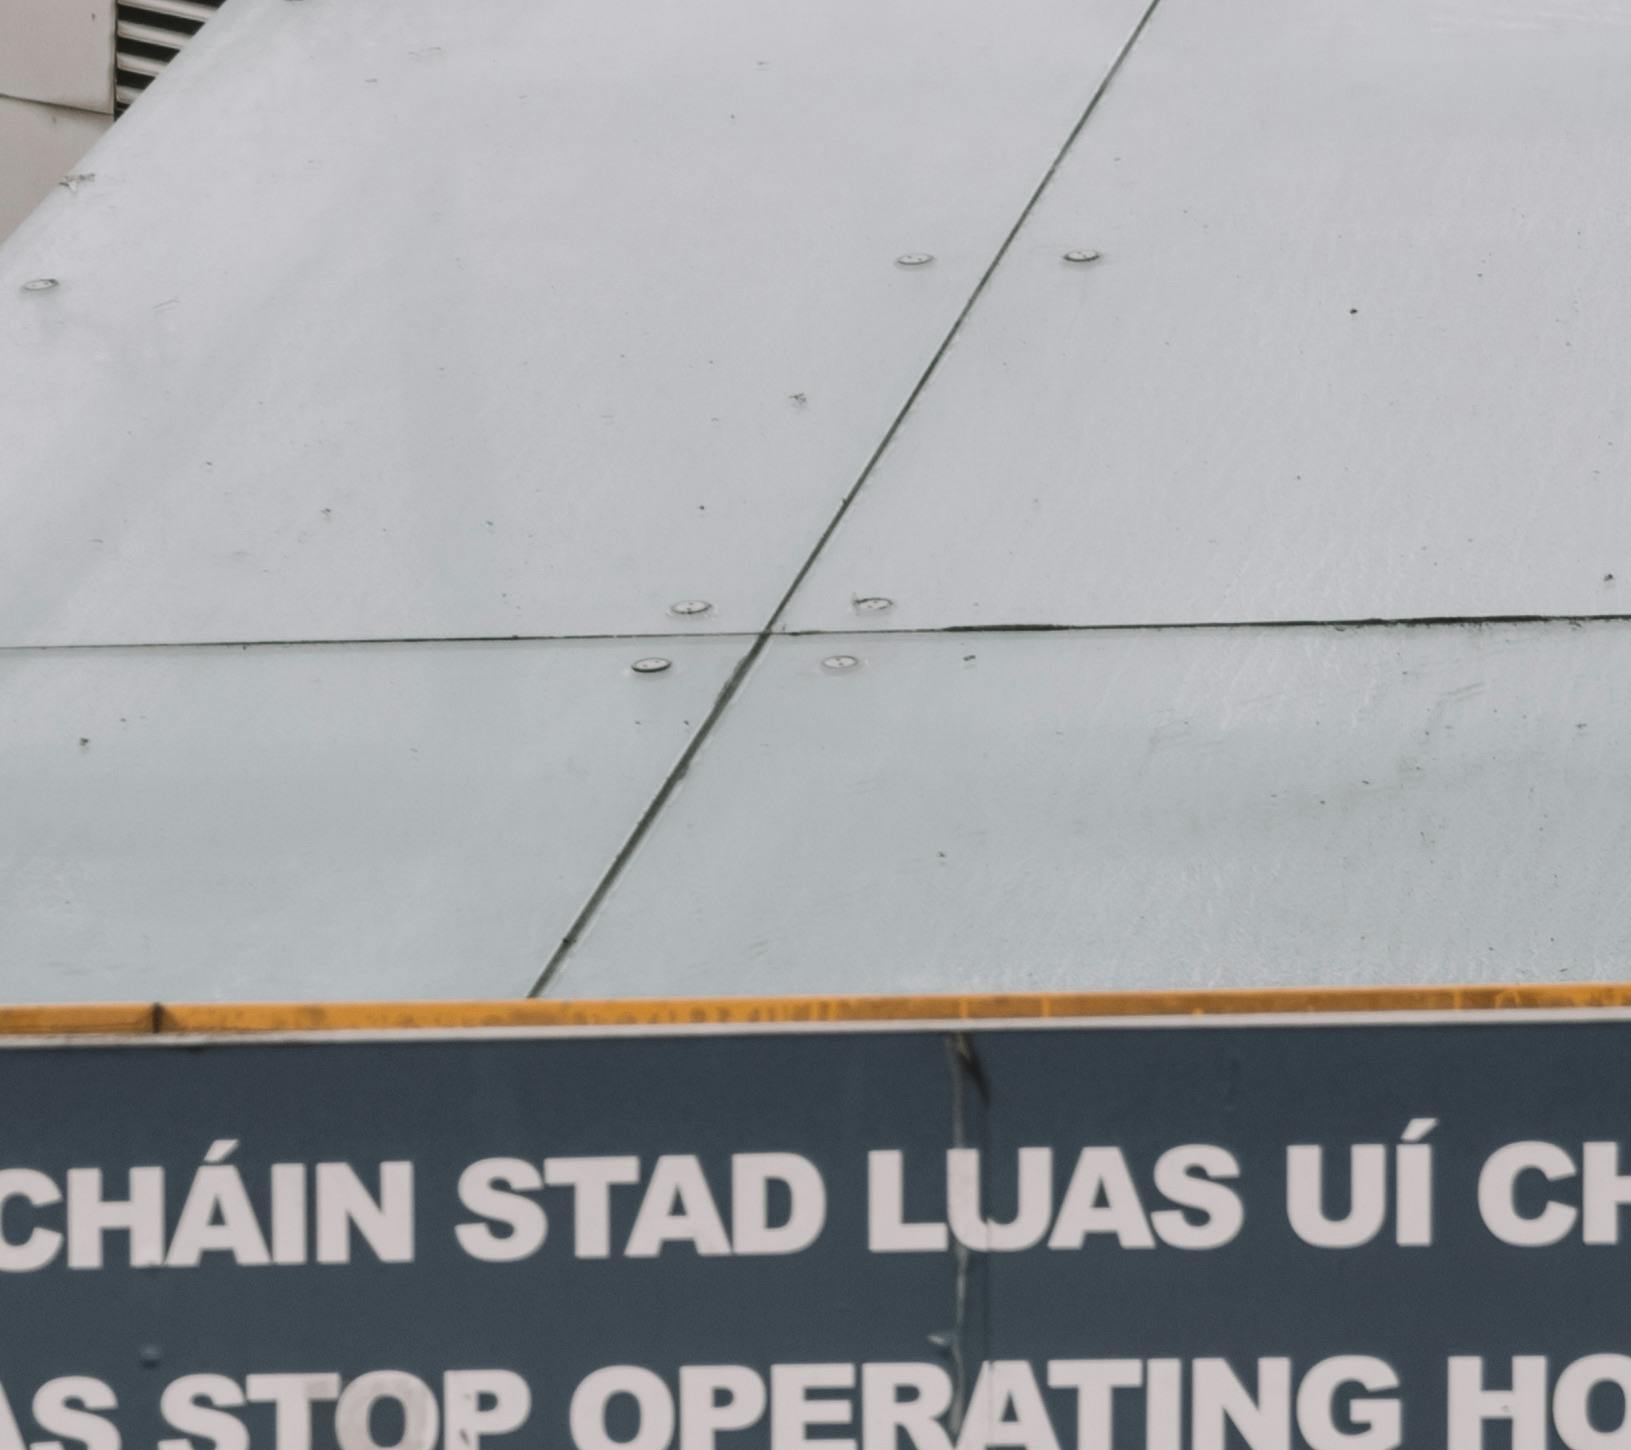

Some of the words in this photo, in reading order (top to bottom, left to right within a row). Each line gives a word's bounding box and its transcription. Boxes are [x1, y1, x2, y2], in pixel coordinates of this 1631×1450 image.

[455, 1152, 826, 1263] STAD
[868, 1145, 1244, 1252] LUAS
[1286, 1118, 1436, 1249] UÍ
